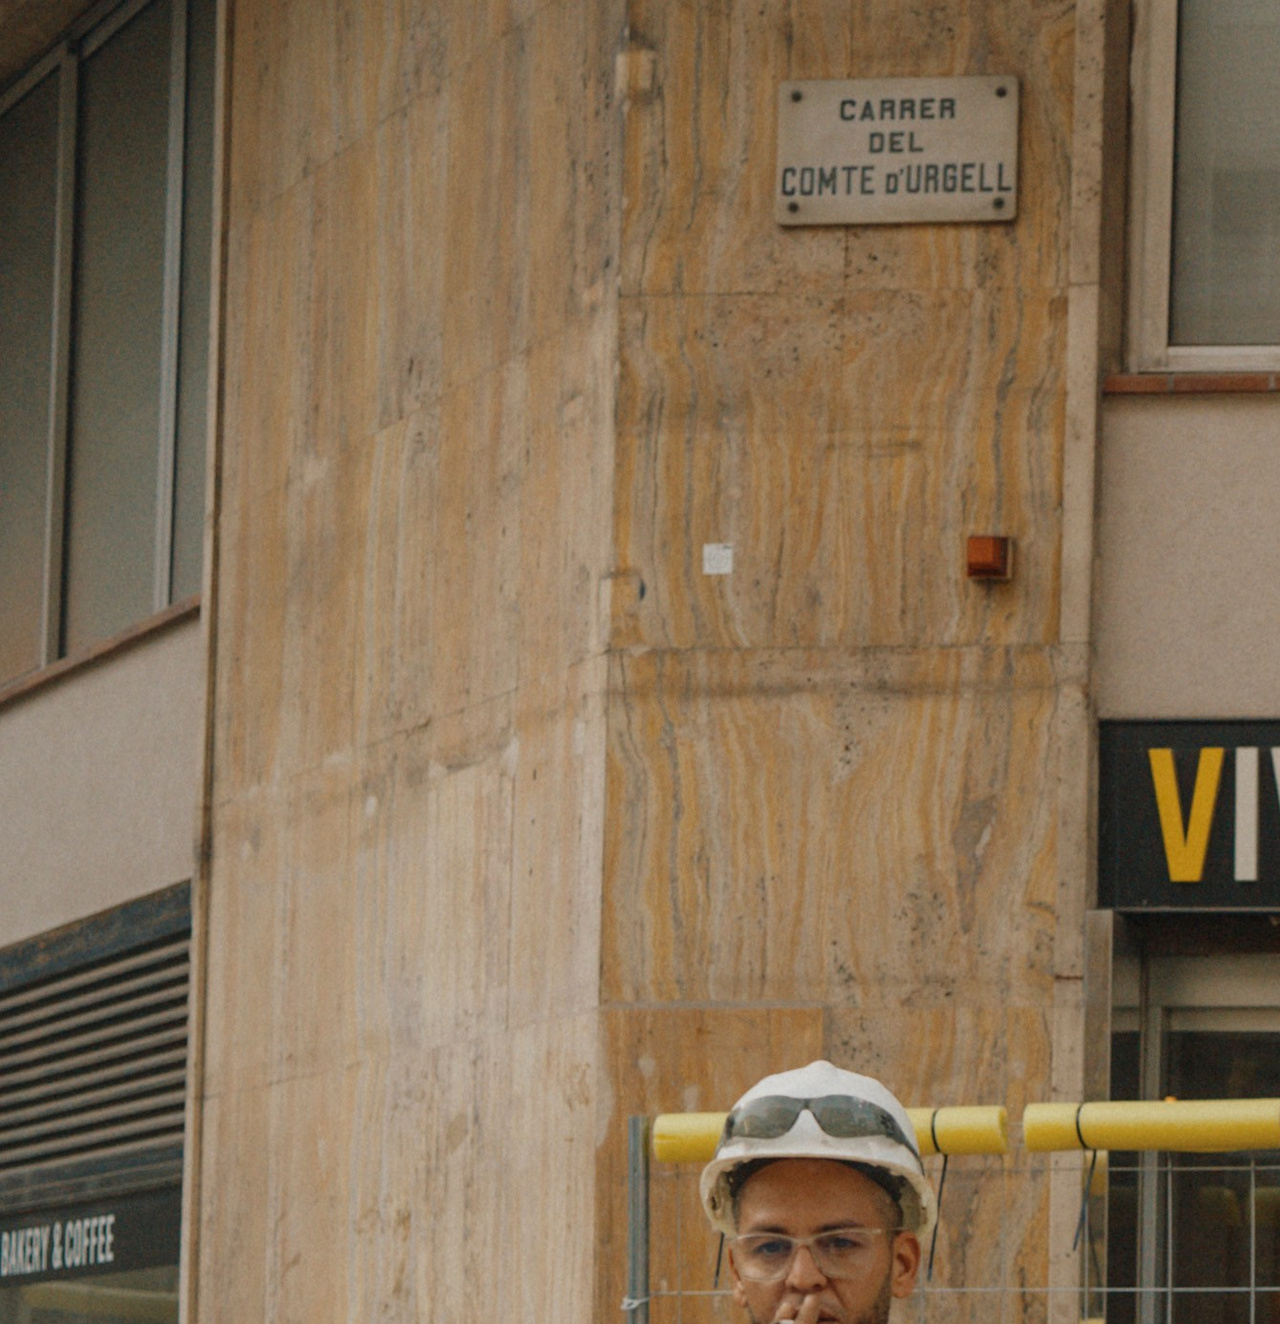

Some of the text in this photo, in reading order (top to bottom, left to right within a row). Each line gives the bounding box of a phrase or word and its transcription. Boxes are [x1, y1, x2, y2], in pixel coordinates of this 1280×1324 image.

[839, 98, 956, 122] CARRER
[869, 132, 924, 153] DEL
[781, 166, 875, 196] COMTE
[0, 1213, 116, 1277] BAKERY & COFFEE
